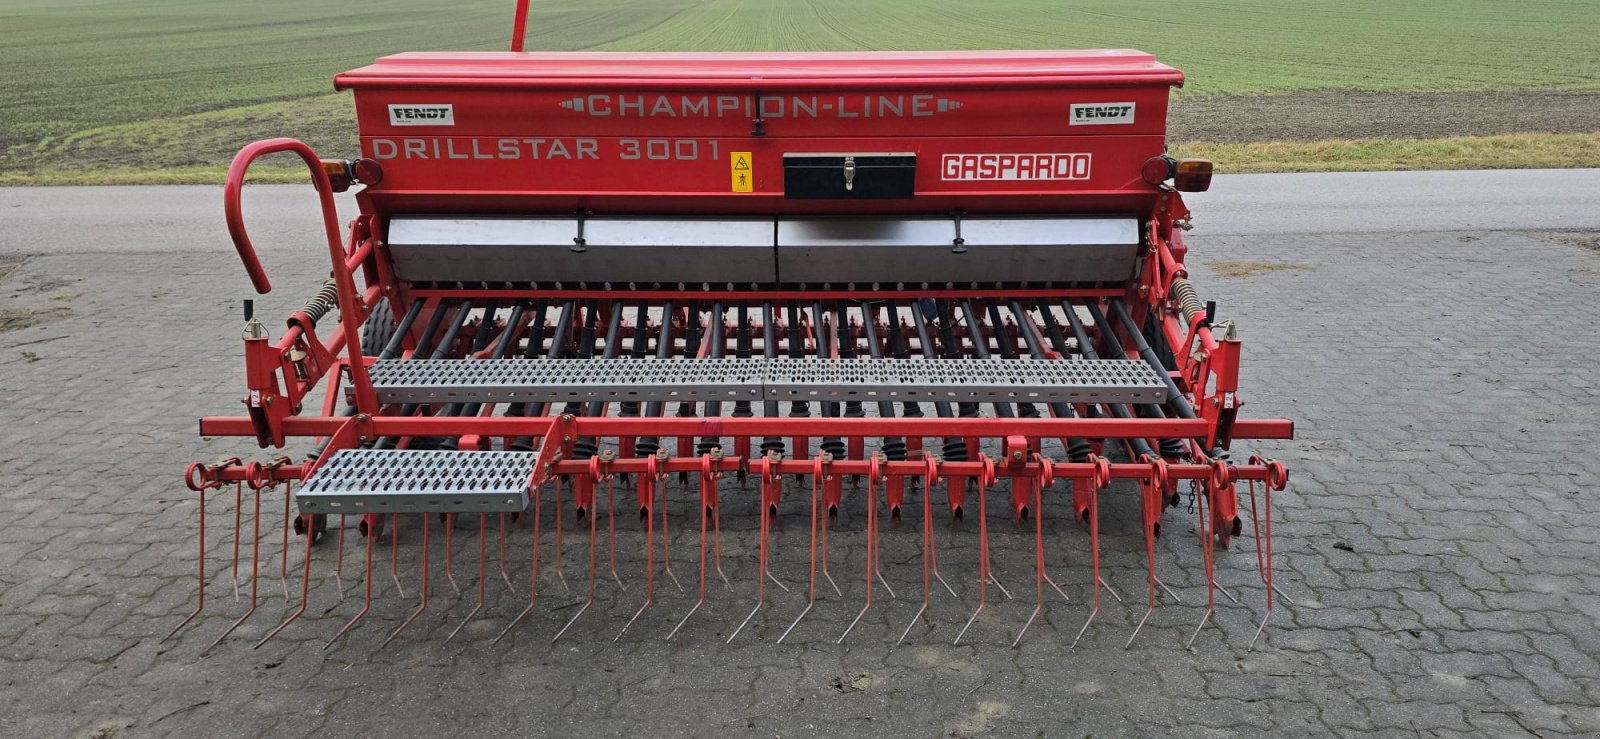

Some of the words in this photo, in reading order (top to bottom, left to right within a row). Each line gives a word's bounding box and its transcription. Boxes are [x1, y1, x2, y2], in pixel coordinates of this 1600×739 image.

[393, 108, 449, 119] FENDT
[588, 94, 933, 118] CHAMPION-LINE
[1074, 106, 1132, 118] FENDT
[373, 138, 600, 160] DRILLSTAR
[619, 139, 719, 160] 3001
[942, 154, 1090, 179] GASPARDO
